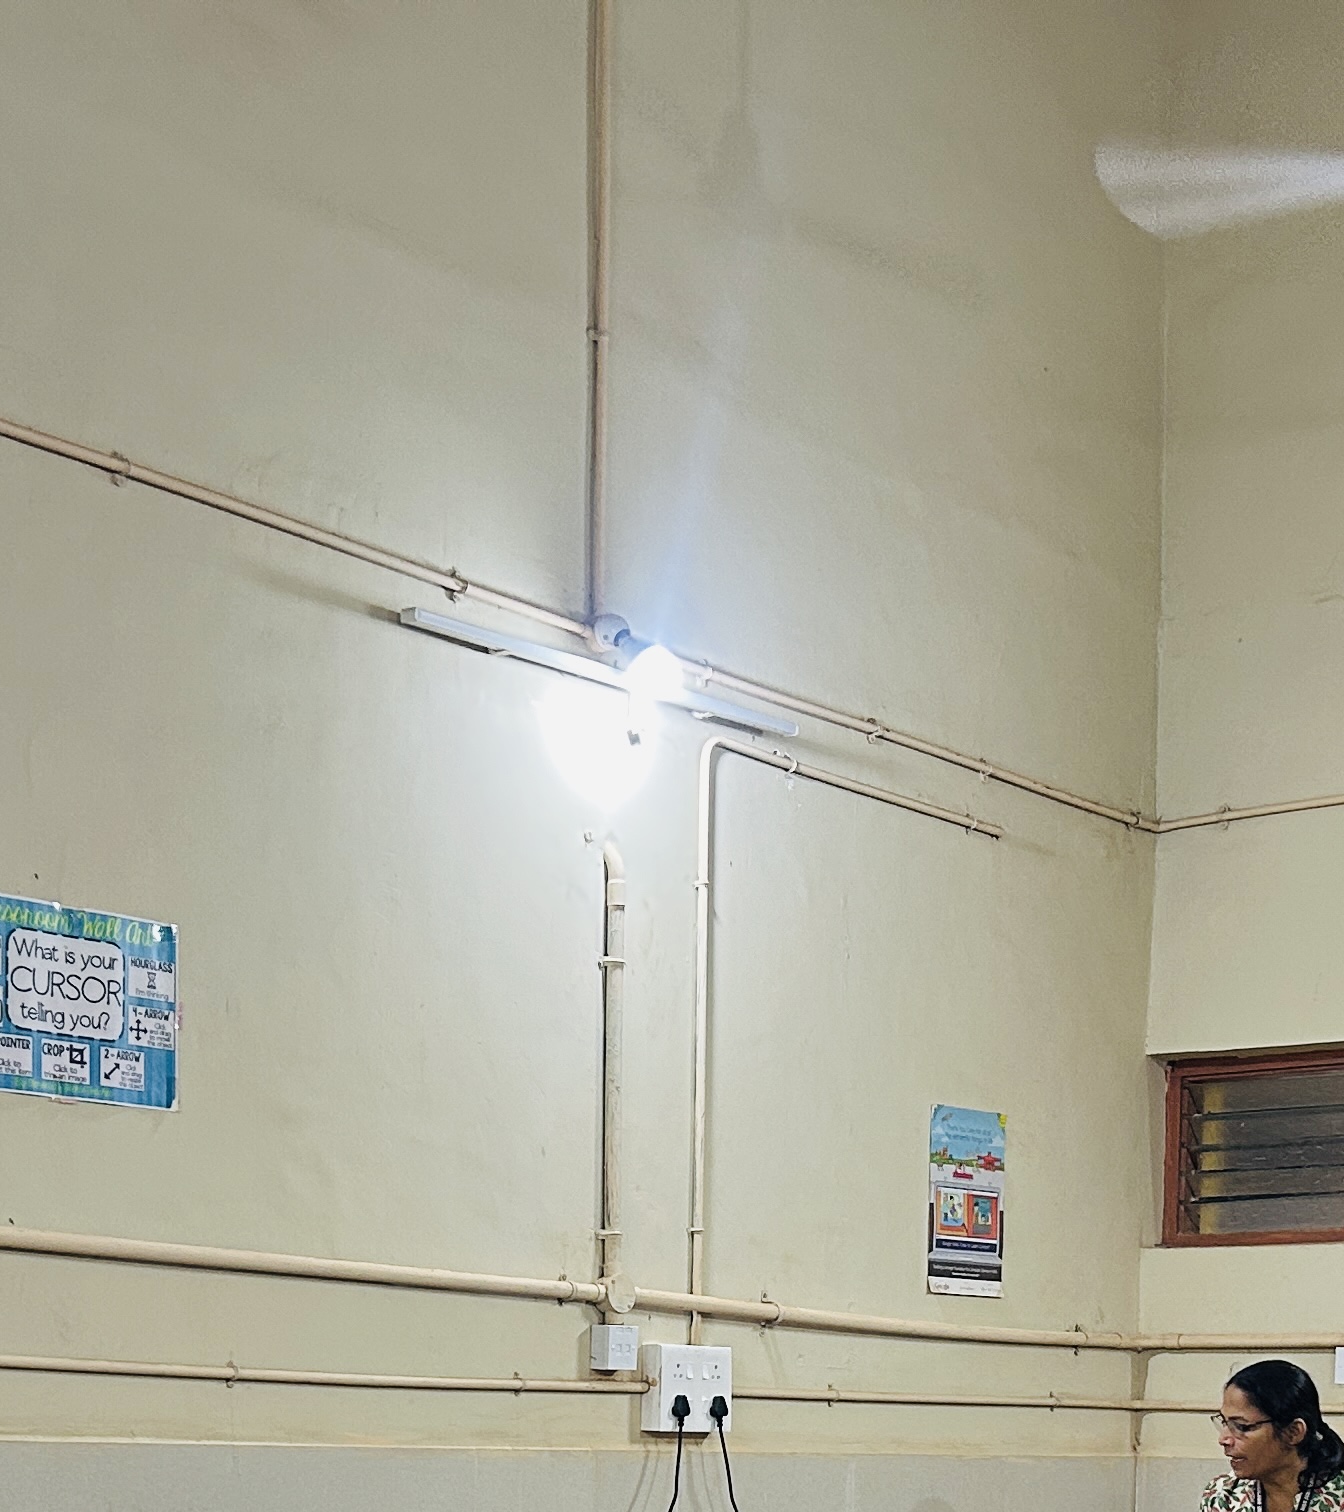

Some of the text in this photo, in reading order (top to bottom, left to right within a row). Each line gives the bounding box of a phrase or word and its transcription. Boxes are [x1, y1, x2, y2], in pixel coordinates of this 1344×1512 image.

[78, 911, 122, 942] Wall
[13, 936, 118, 972] What is your
[131, 957, 173, 974] HOURGLASS
[10, 966, 122, 1007] CURSOR
[69, 1012, 110, 1032] you?
[42, 1042, 65, 1057] CROP
